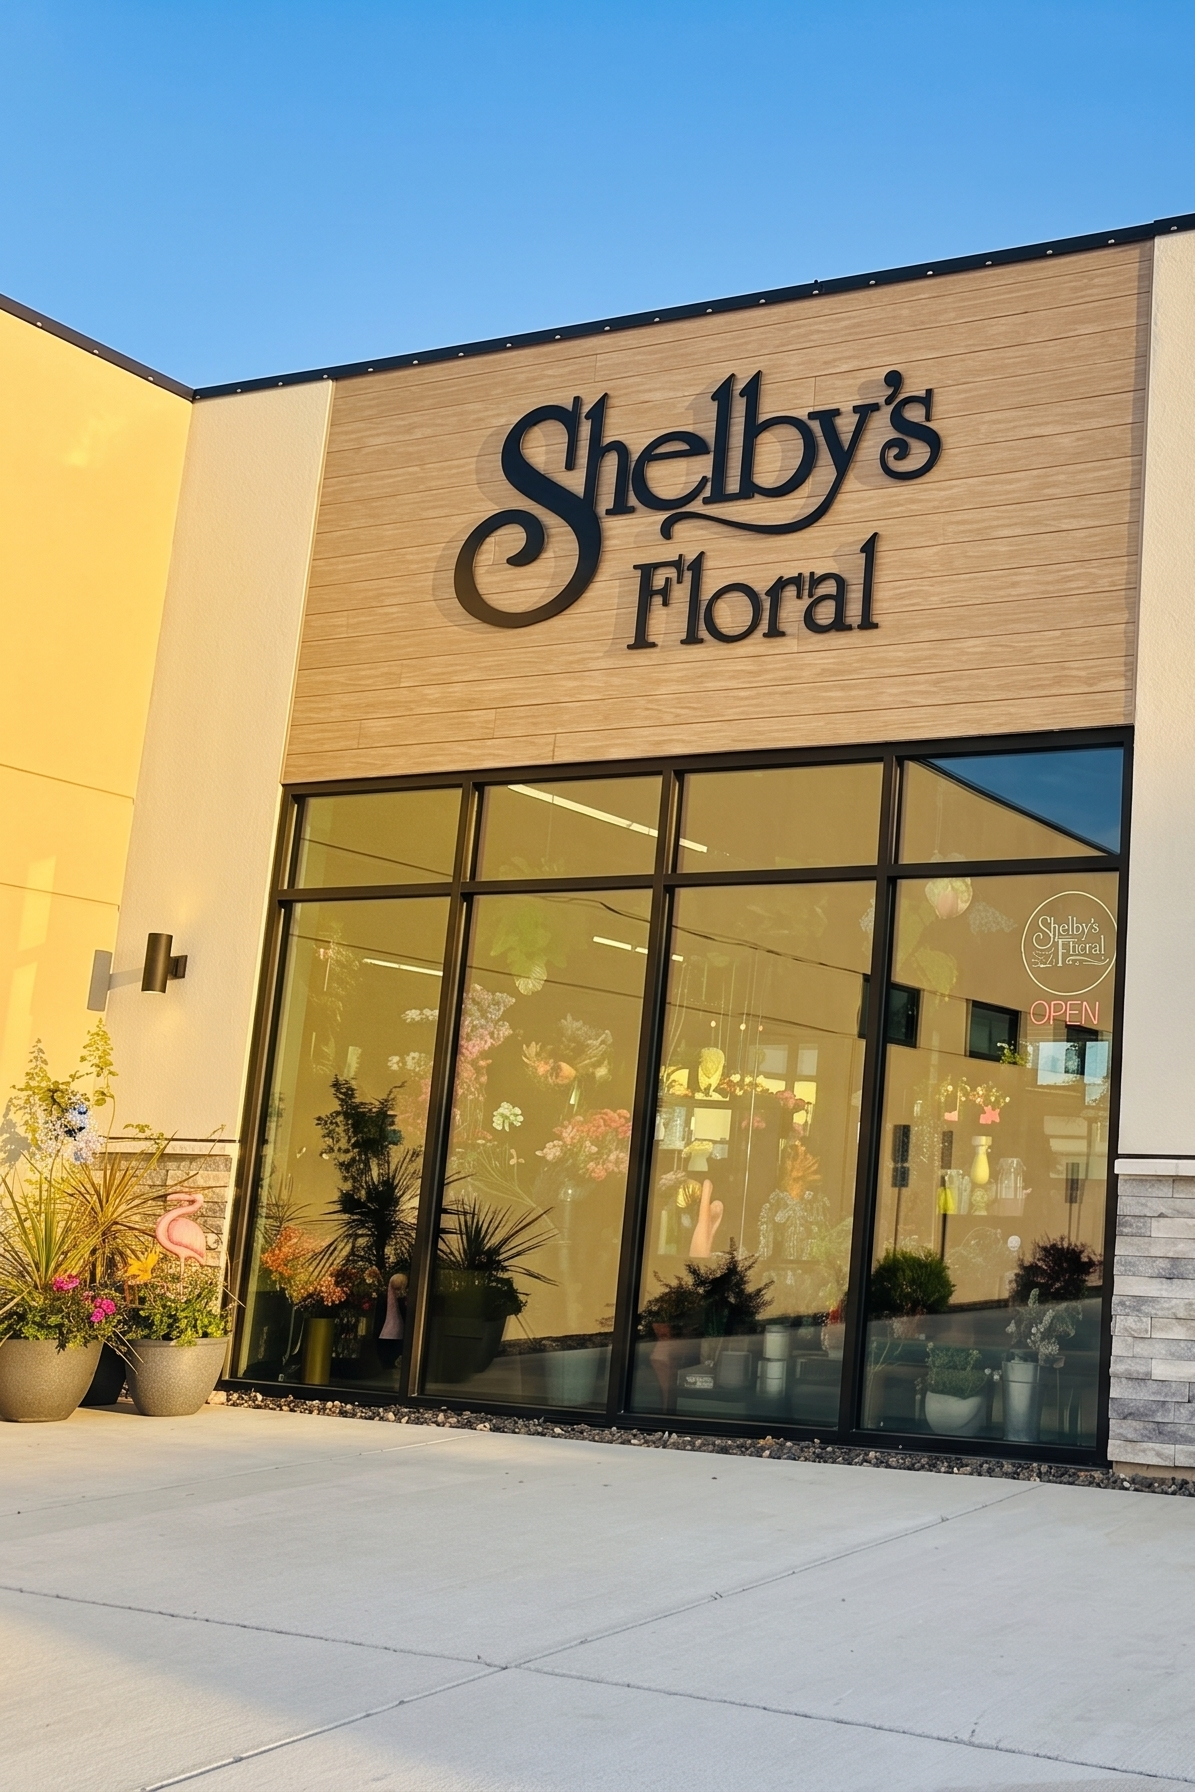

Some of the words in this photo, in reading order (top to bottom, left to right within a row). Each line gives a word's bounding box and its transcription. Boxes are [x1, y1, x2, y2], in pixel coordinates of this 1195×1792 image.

[454, 369, 943, 628] Shelby's
[627, 532, 880, 650] Floral
[1033, 915, 1099, 949] Shelby's
[1030, 1000, 1099, 1025] OPEN
